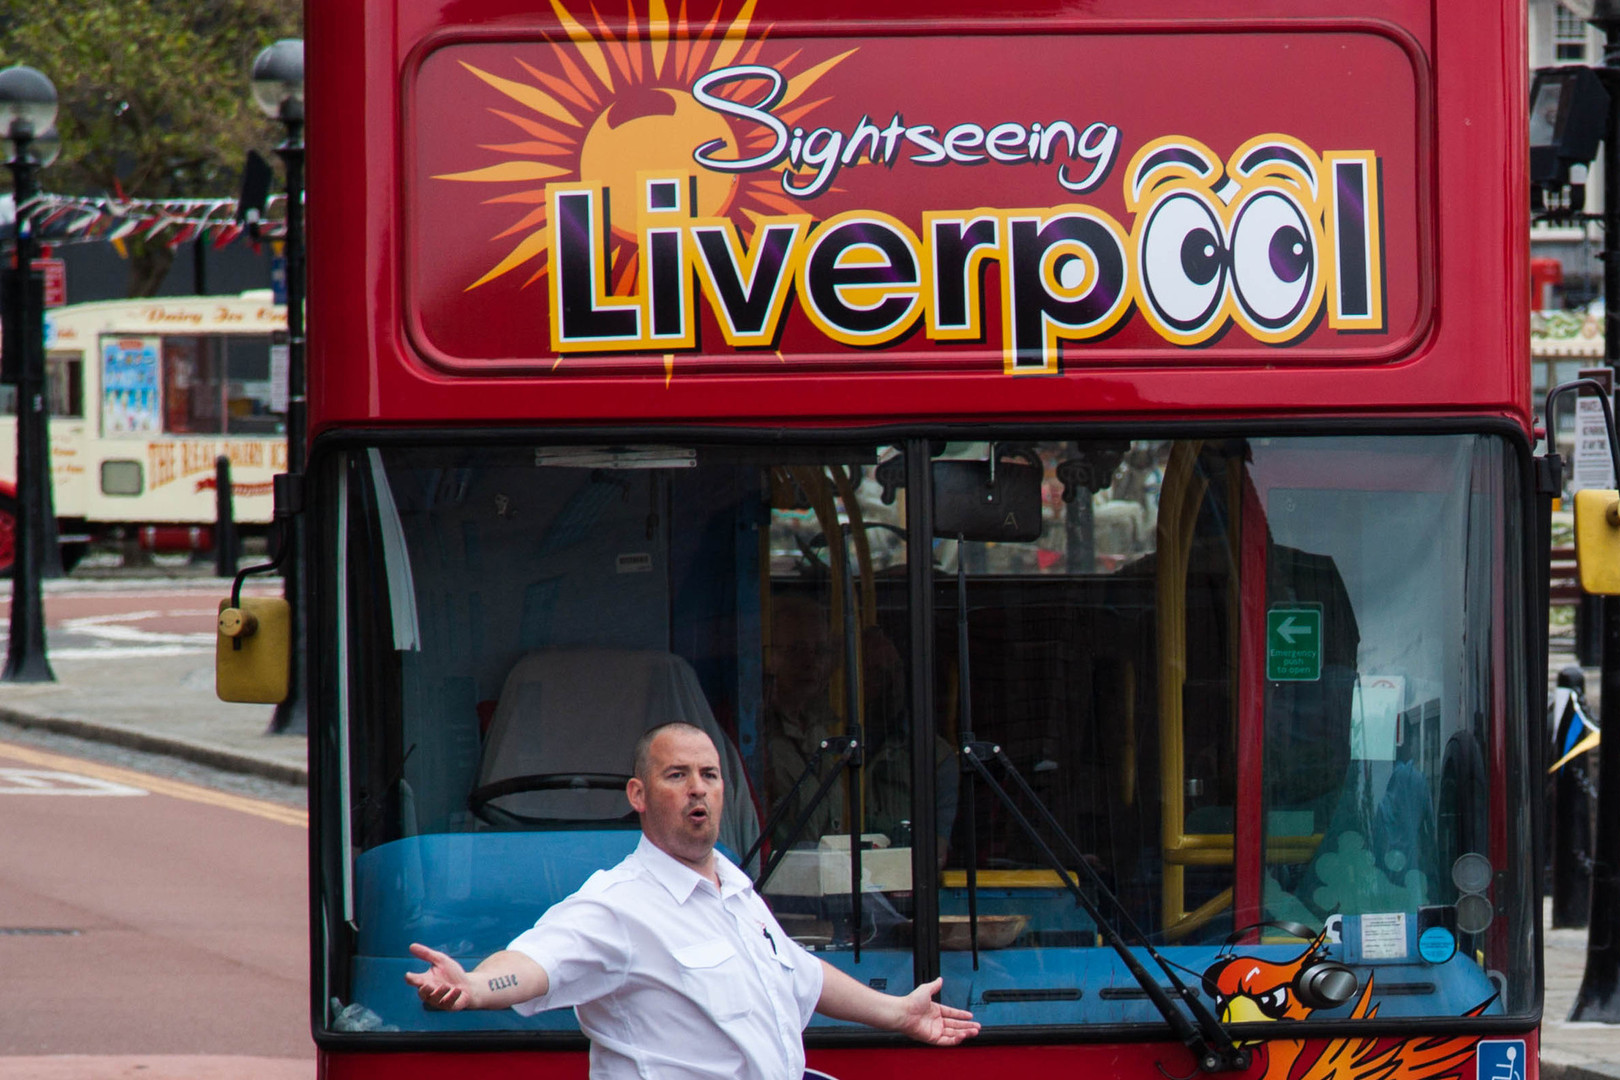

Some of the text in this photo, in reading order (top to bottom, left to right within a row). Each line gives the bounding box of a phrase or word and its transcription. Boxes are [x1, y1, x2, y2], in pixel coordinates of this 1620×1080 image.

[692, 65, 1119, 198] Sightseeing
[548, 148, 1384, 376] Liverpool
[1270, 649, 1317, 659] Emergency
[1277, 666, 1311, 675] to open
